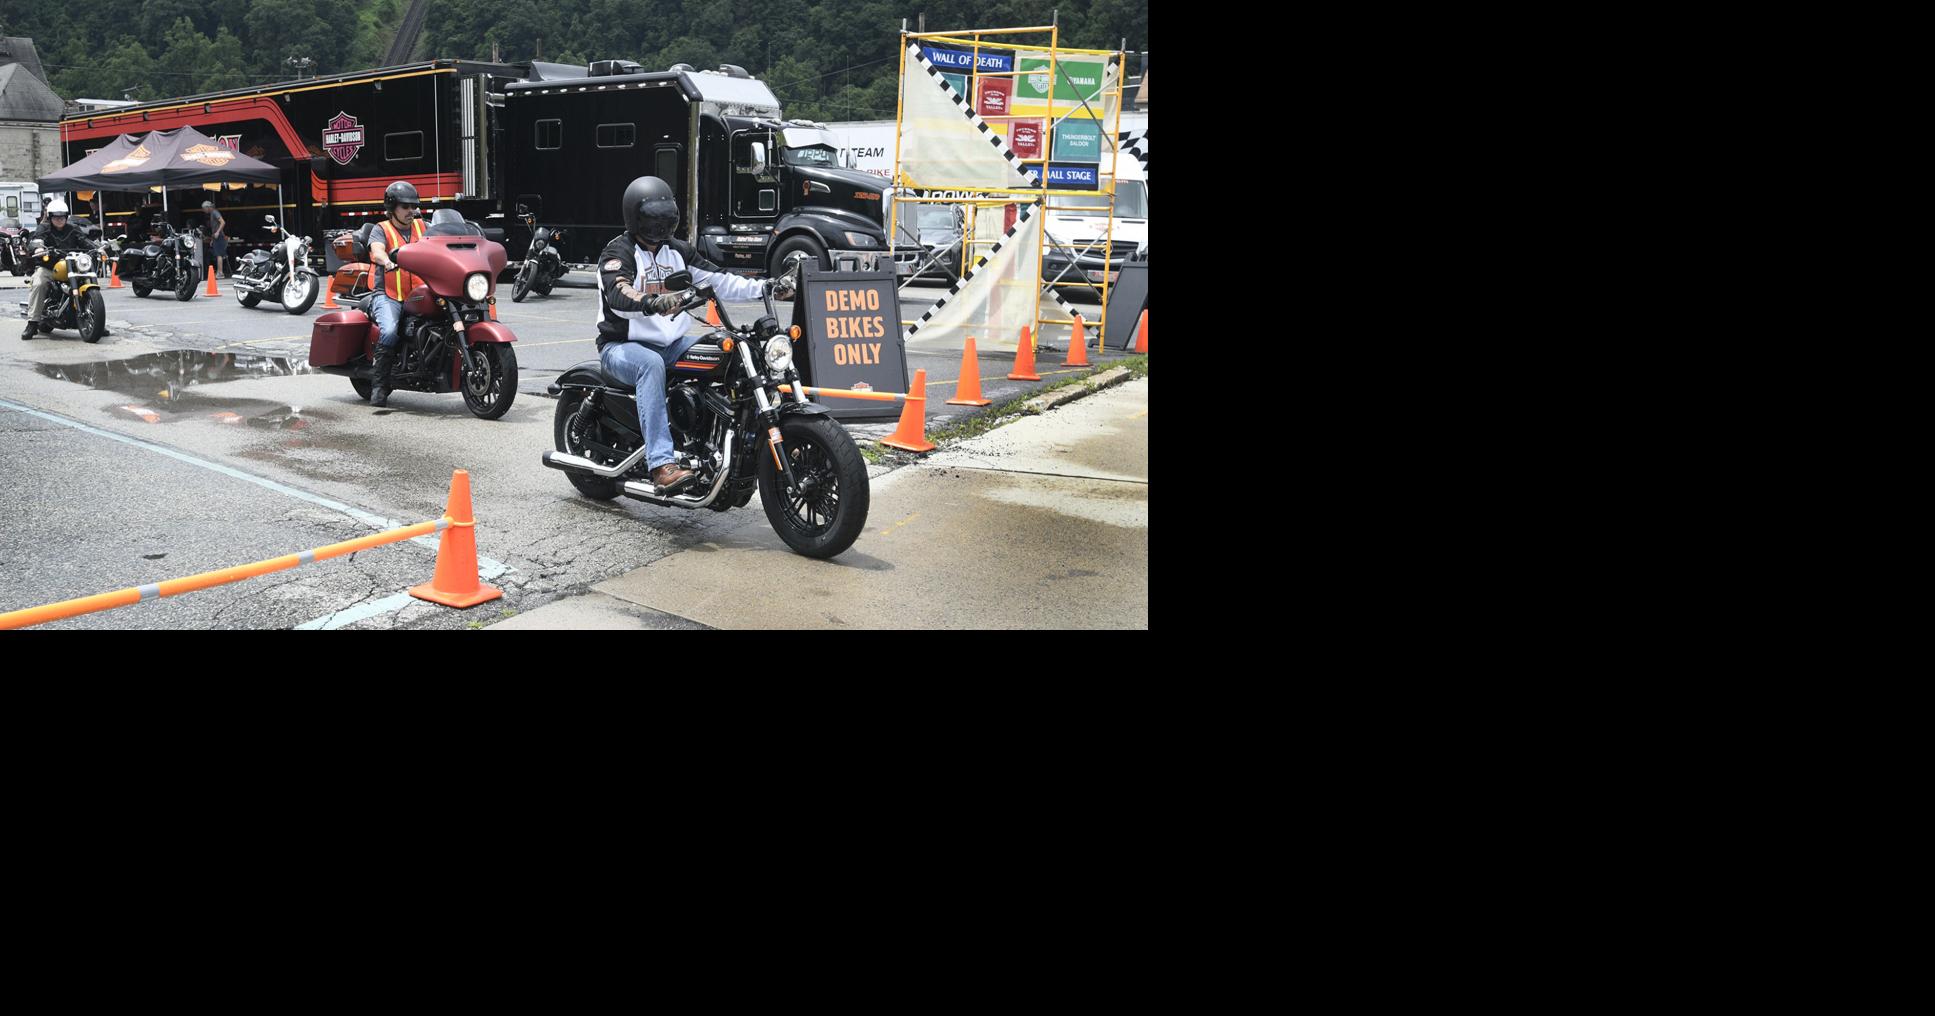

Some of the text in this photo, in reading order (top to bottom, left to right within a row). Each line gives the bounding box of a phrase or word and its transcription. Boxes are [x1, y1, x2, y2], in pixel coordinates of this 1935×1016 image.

[932, 51, 1003, 69] WALL OF DEATH
[333, 118, 352, 129] MOTOR
[1066, 171, 1092, 181] STAGE
[825, 289, 880, 311] DEMO
[826, 315, 885, 338] BIKES
[834, 343, 882, 366] ONLY
